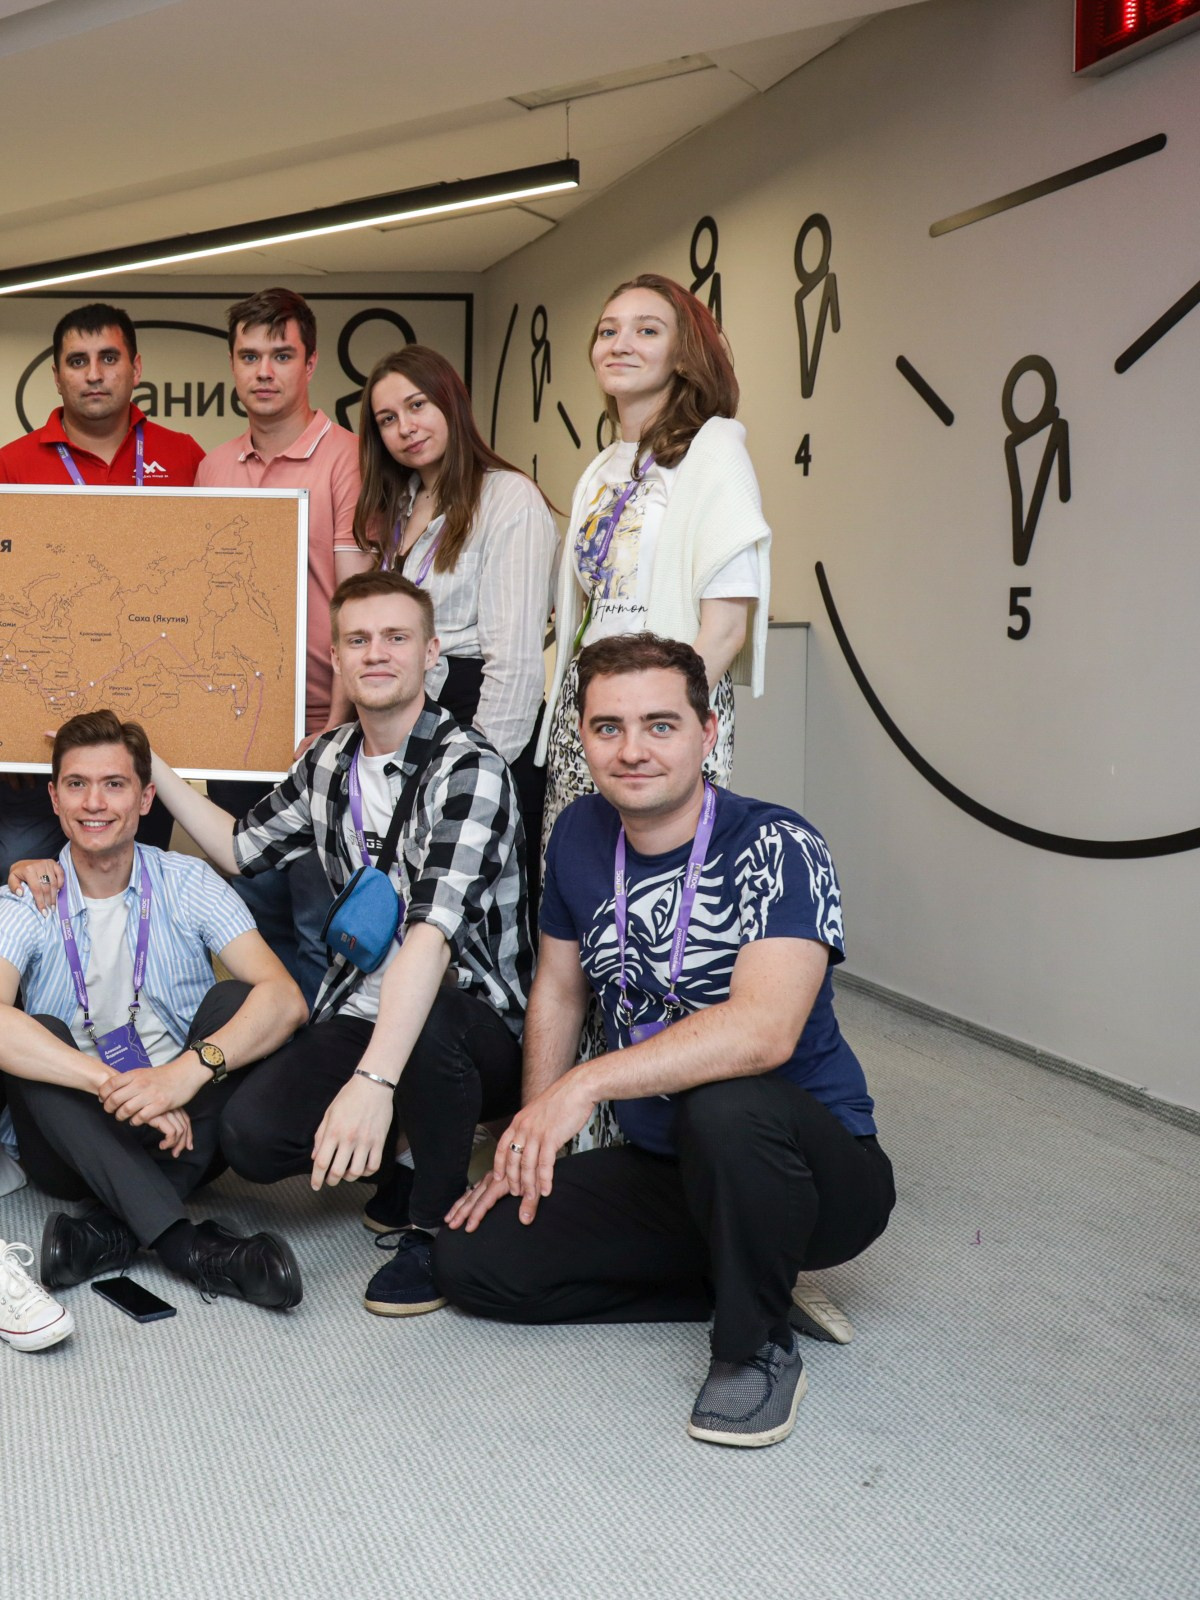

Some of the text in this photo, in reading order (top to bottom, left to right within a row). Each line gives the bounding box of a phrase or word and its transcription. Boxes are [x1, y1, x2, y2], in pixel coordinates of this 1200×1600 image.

[794, 433, 812, 477] 4
[127, 613, 190, 625] Саха (Якутия)
[1007, 586, 1032, 641] 5
[670, 927, 683, 973] росмолодёжь
